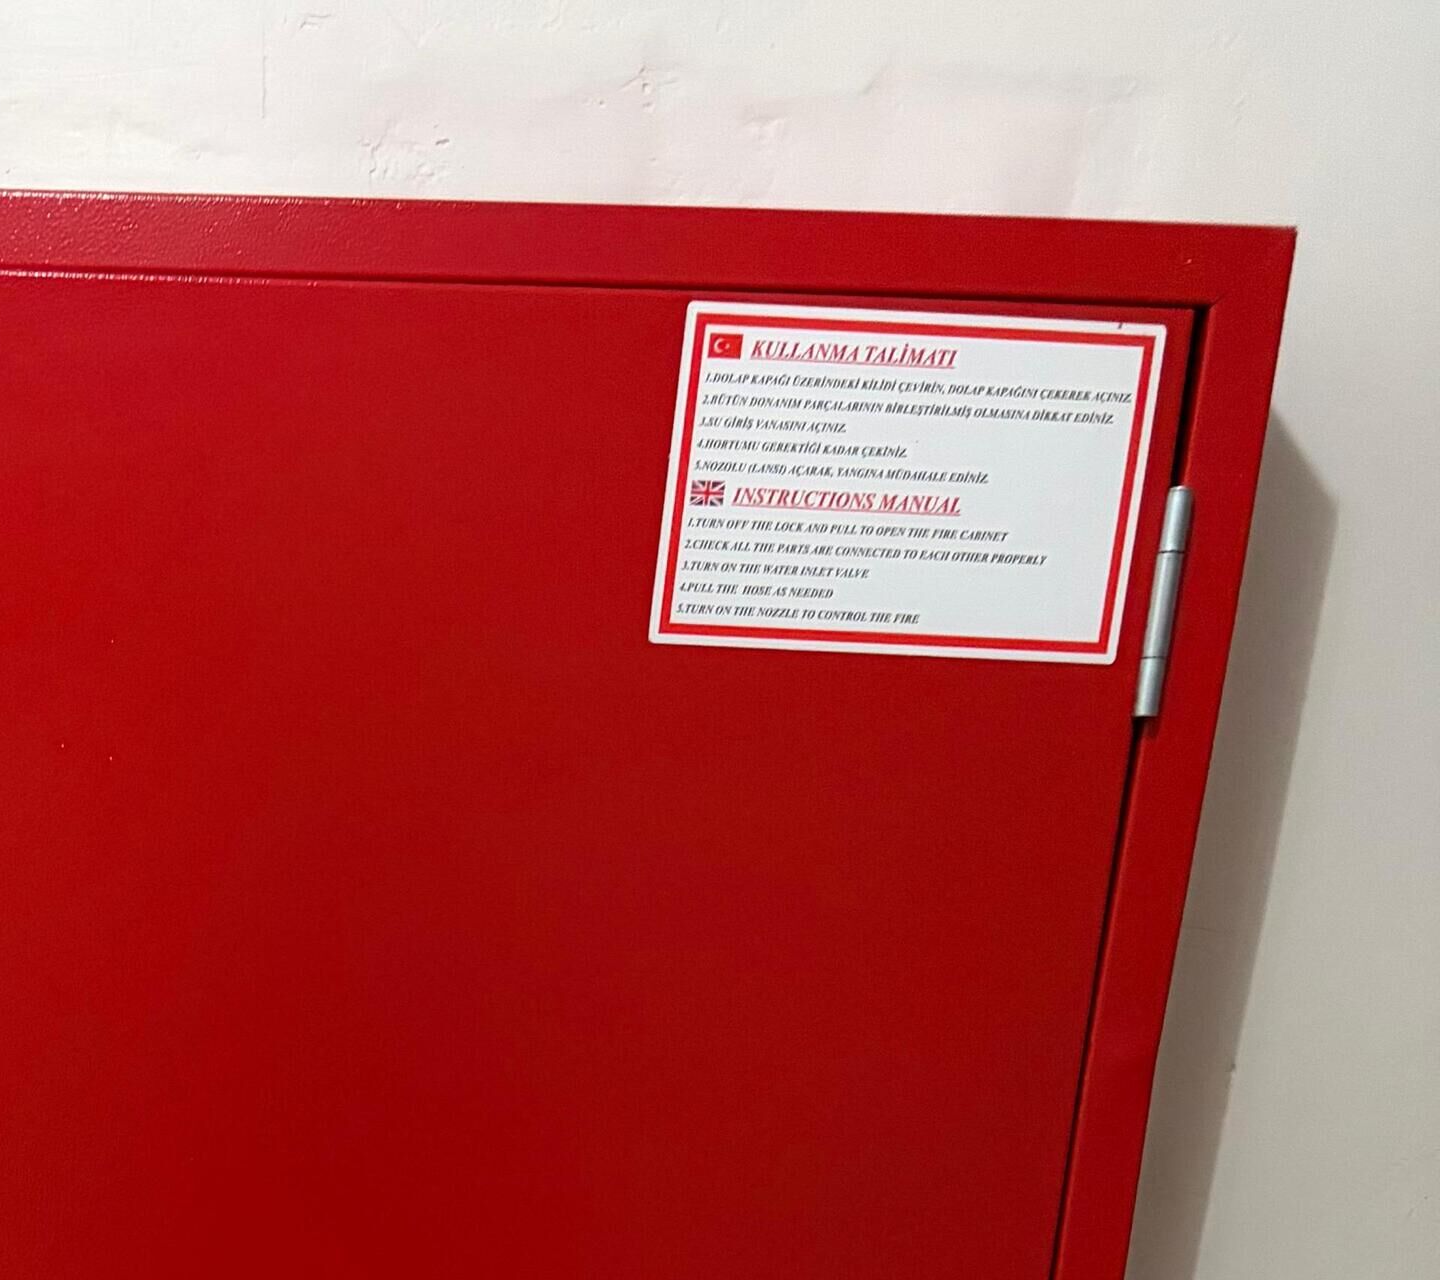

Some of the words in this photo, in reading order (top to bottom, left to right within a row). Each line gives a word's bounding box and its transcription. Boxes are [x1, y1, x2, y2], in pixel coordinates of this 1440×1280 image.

[750, 340, 859, 363] KULLANMA
[865, 343, 957, 368] TALİMATI
[792, 374, 860, 389] ÜZERİNDEKİ
[860, 379, 896, 391] KİLİDİ
[948, 384, 985, 395] DOLAP
[985, 385, 1038, 399] KAPAĞINI
[1040, 389, 1091, 401] ÇEKEREK
[749, 397, 802, 409] DONANIM
[803, 400, 883, 413] PARÇALARININ
[974, 408, 1030, 420] OLMASINA
[1032, 409, 1073, 423] DİKKAT
[724, 416, 753, 430] GİRİŞ
[754, 419, 805, 431] VANASINI
[762, 441, 821, 453] GEREKTİĞİ
[823, 444, 859, 456] KADAR
[837, 467, 886, 479] YANGINA
[886, 467, 947, 483] MÜDAHALE
[732, 487, 876, 511] INSTRUCTIONS
[879, 494, 961, 515] MANUAL
[726, 520, 747, 529] OFF
[751, 520, 772, 531] THE
[774, 522, 803, 532] LOCK
[805, 522, 827, 533] AND
[830, 524, 858, 535] PULL
[861, 526, 873, 536] TO
[876, 526, 906, 537] OPEN
[908, 527, 930, 538] THE
[931, 528, 958, 539] FIRE
[960, 530, 1009, 542] CABINET
[684, 539, 729, 550] 2.CHECK
[731, 541, 750, 551] ALL
[754, 542, 774, 552] THE
[777, 543, 809, 554] PARTS
[811, 546, 832, 555] ARE
[835, 546, 901, 559] CONNECTED
[904, 549, 918, 559] TO
[919, 550, 950, 561] EACH
[952, 551, 988, 563] OTHER
[990, 553, 1047, 566] PROPERLY
[720, 562, 737, 572] ON
[739, 563, 761, 573] THE
[763, 565, 798, 575] WATER
[800, 566, 833, 577] INLET
[835, 567, 869, 578] VALVE
[717, 583, 738, 594] THE
[742, 585, 772, 596] HOSE
[774, 586, 786, 597] AS
[788, 587, 833, 598] NEEDED
[715, 605, 732, 615] ON
[734, 606, 755, 616] THE
[758, 607, 799, 618] NOZZLE
[801, 609, 815, 619] TO
[817, 609, 868, 622] CONTROL
[870, 612, 891, 623] THE
[893, 613, 920, 624] FIRE
